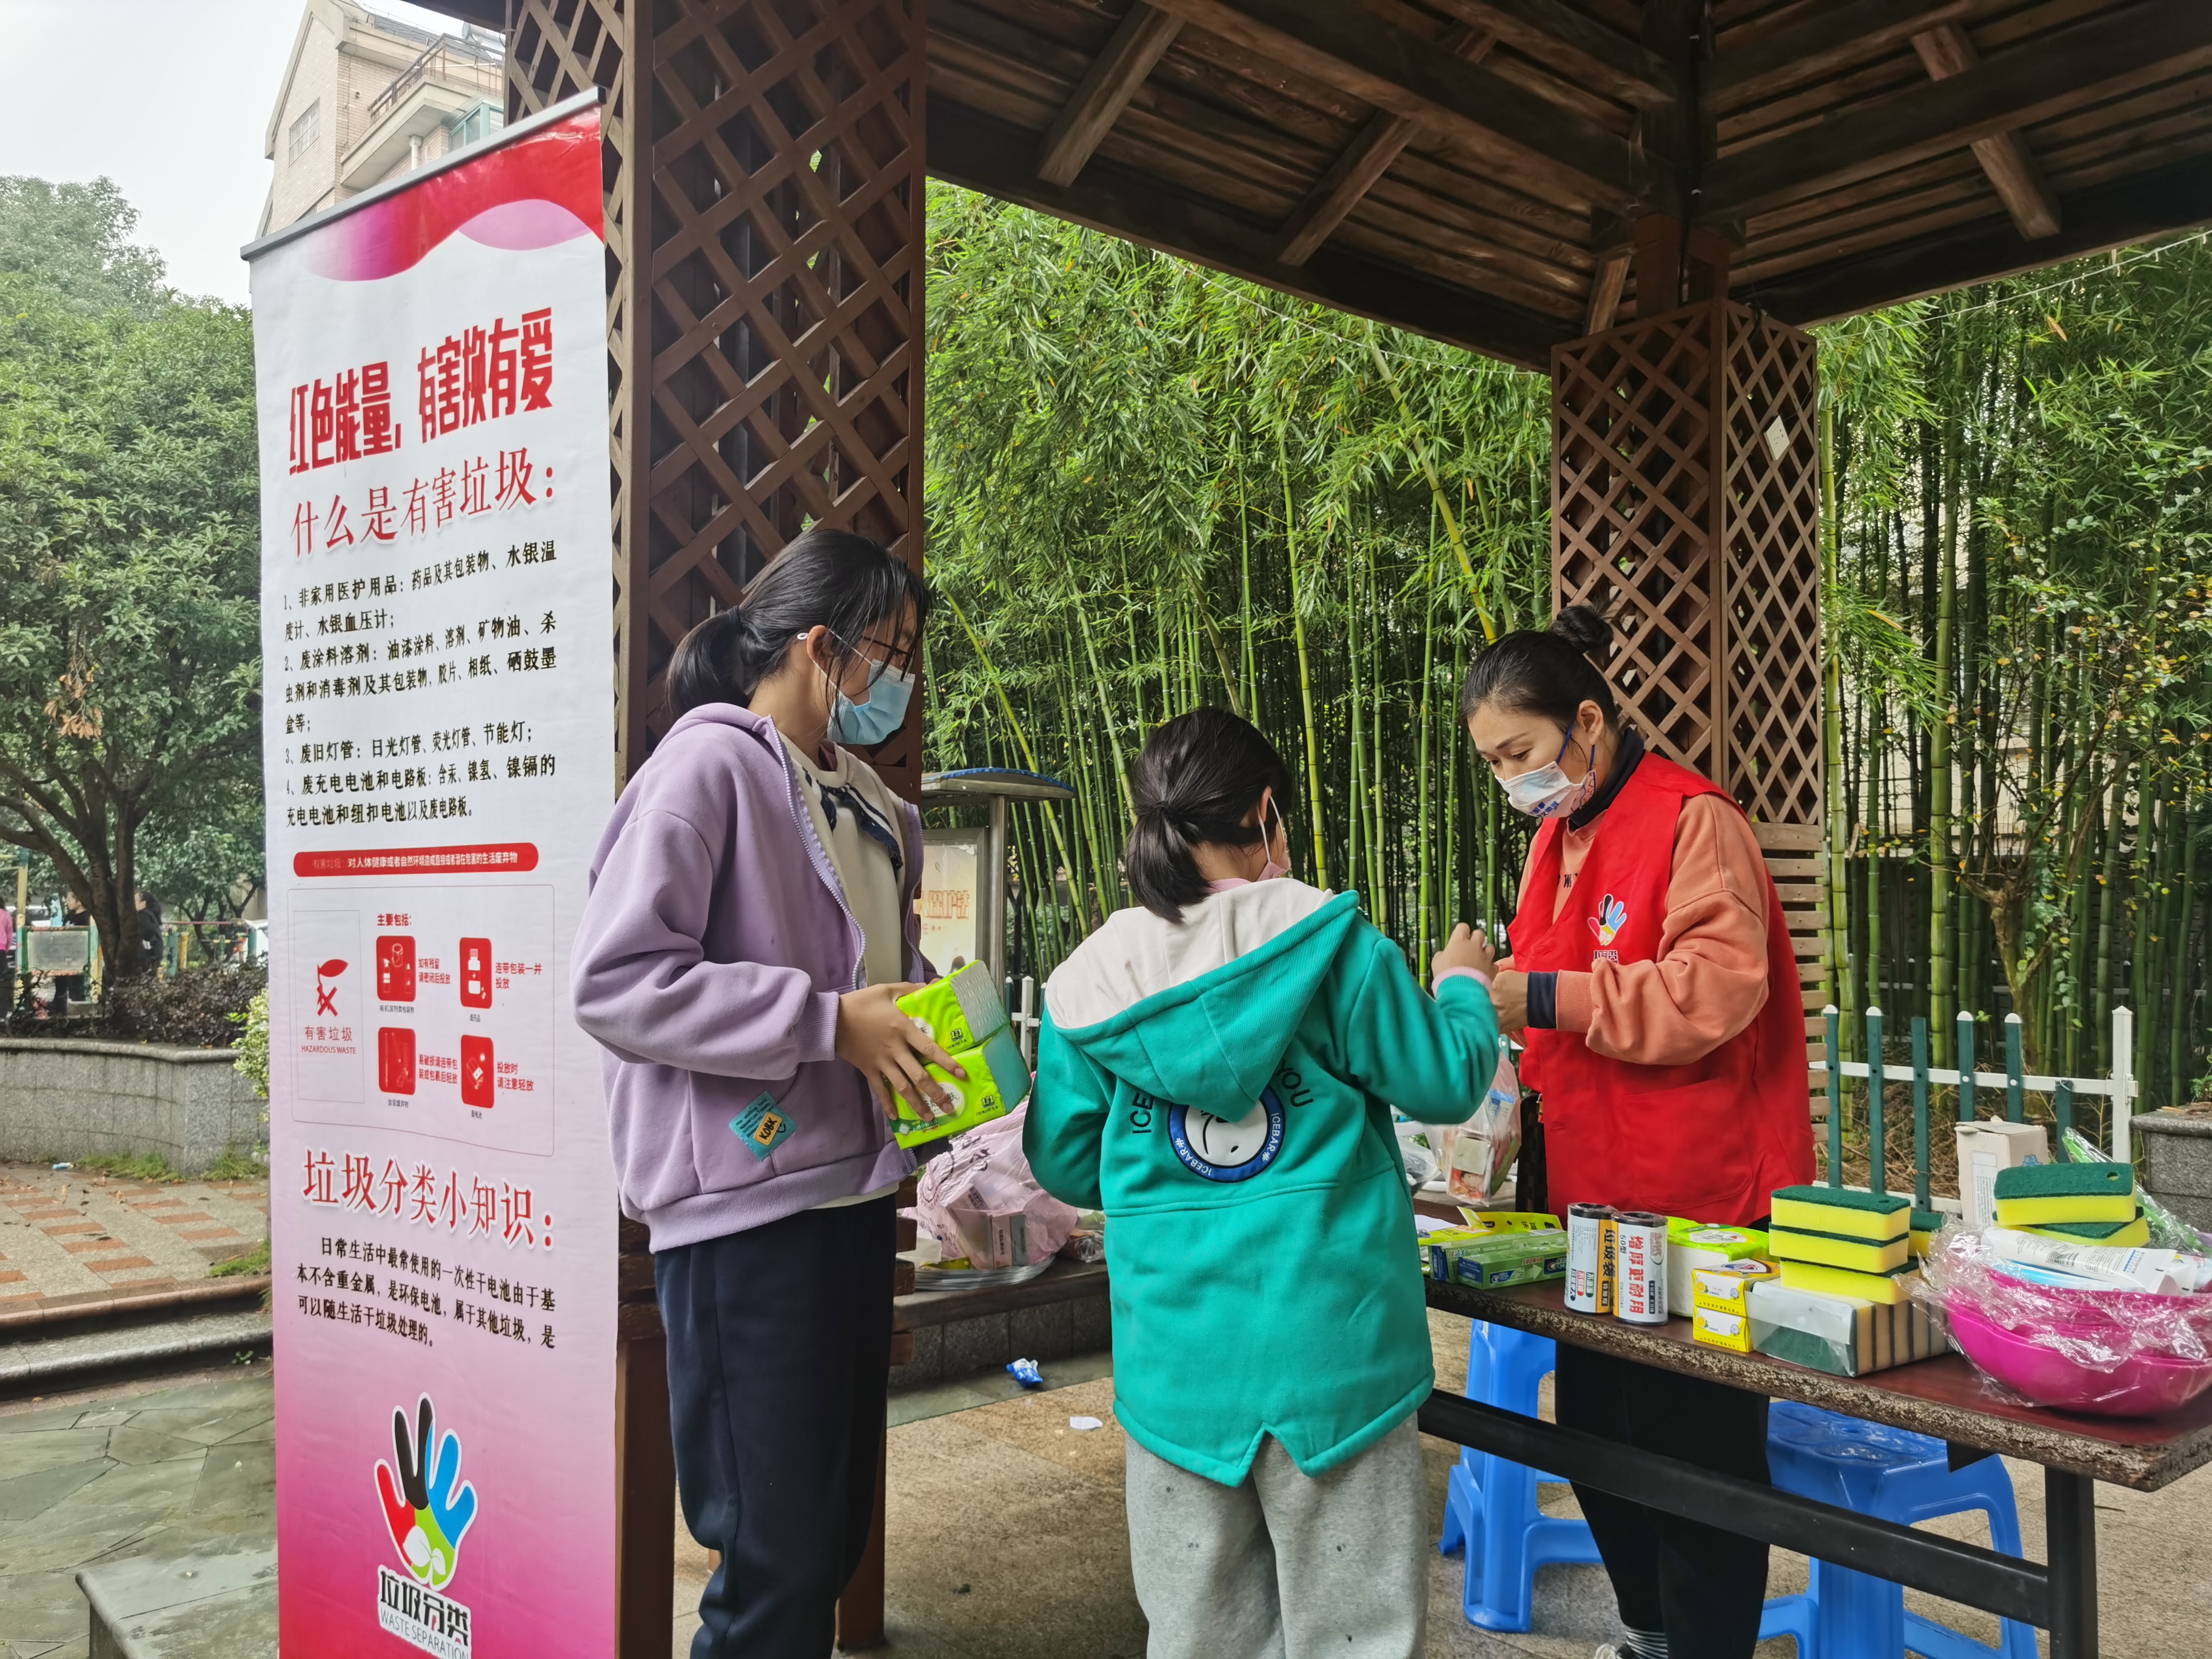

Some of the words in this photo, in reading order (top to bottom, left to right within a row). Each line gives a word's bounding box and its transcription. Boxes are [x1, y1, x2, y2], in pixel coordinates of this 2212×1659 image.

[290, 447, 553, 558] 什么是有害垃圾：
[495, 977, 510, 989] 投放
[304, 1025, 353, 1041] 有害垃圾
[1275, 1057, 1314, 1107] YOU
[759, 1117, 777, 1139] KOBK
[303, 1148, 551, 1247] 垃圾分类小知识：
[1628, 1235, 1644, 1314] 增厚更耐用
[381, 1607, 410, 1637] WASTE
